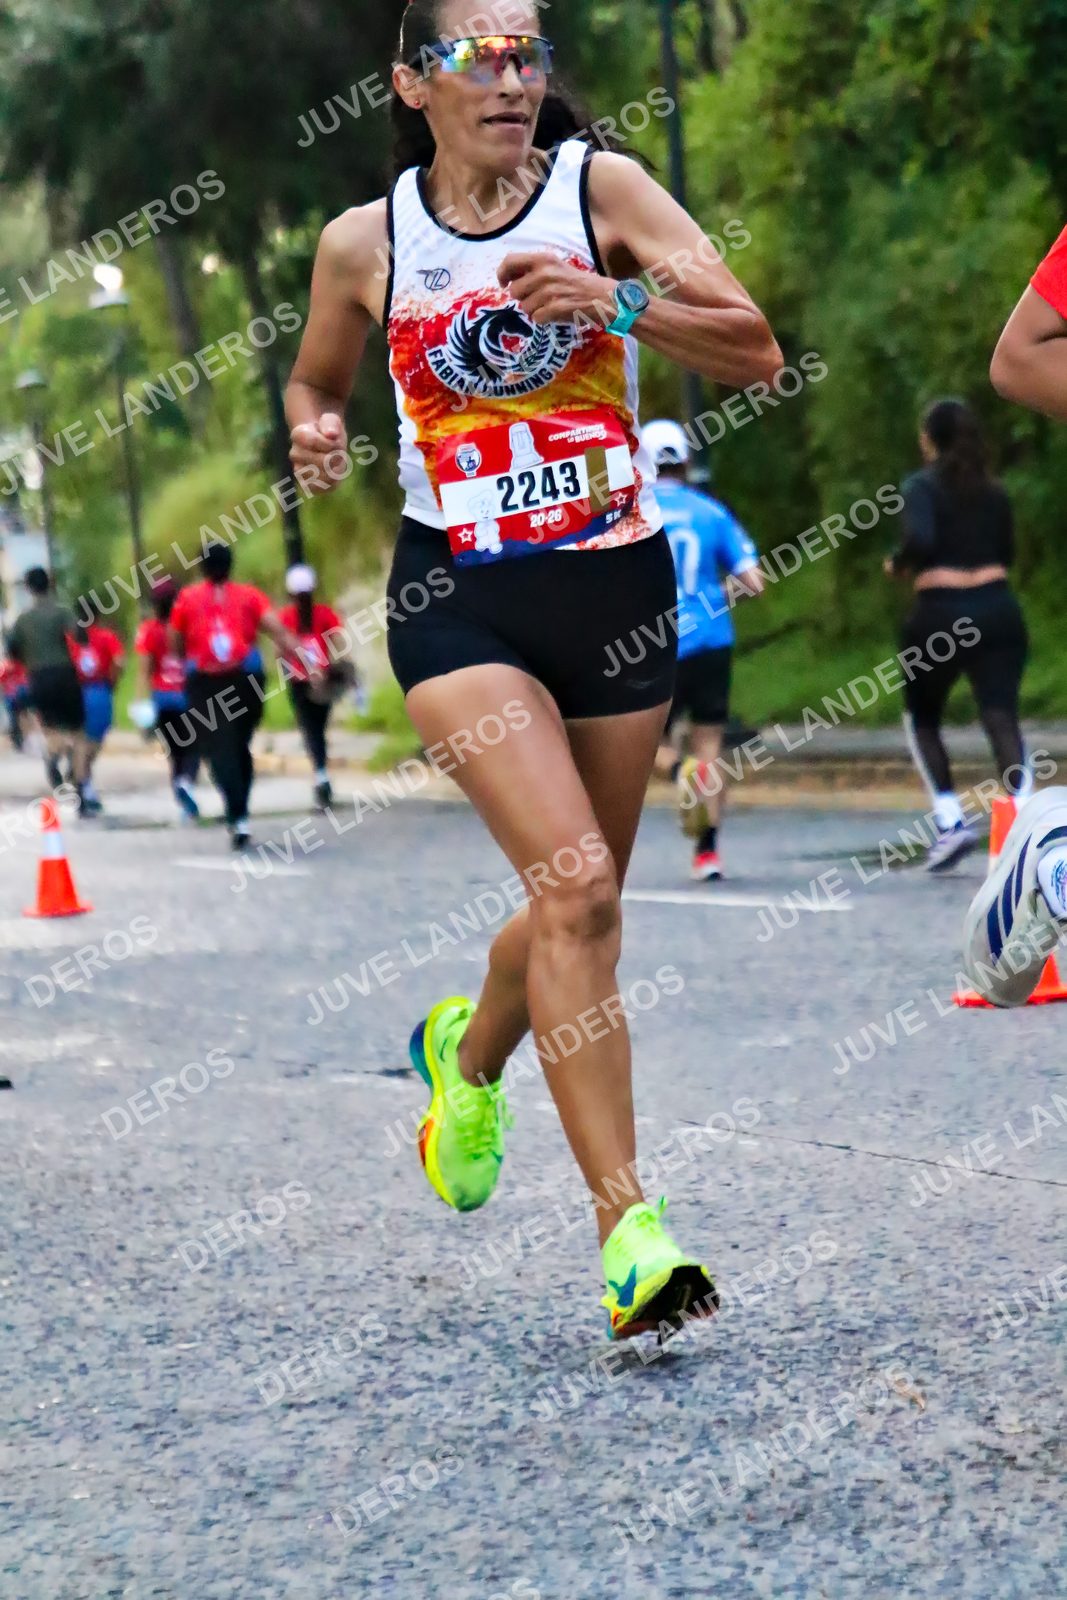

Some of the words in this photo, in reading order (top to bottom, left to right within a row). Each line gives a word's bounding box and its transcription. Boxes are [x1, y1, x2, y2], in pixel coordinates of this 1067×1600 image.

[547, 324, 572, 368] TEAM
[496, 461, 580, 513] 2243
[530, 508, 562, 528] 20-26
